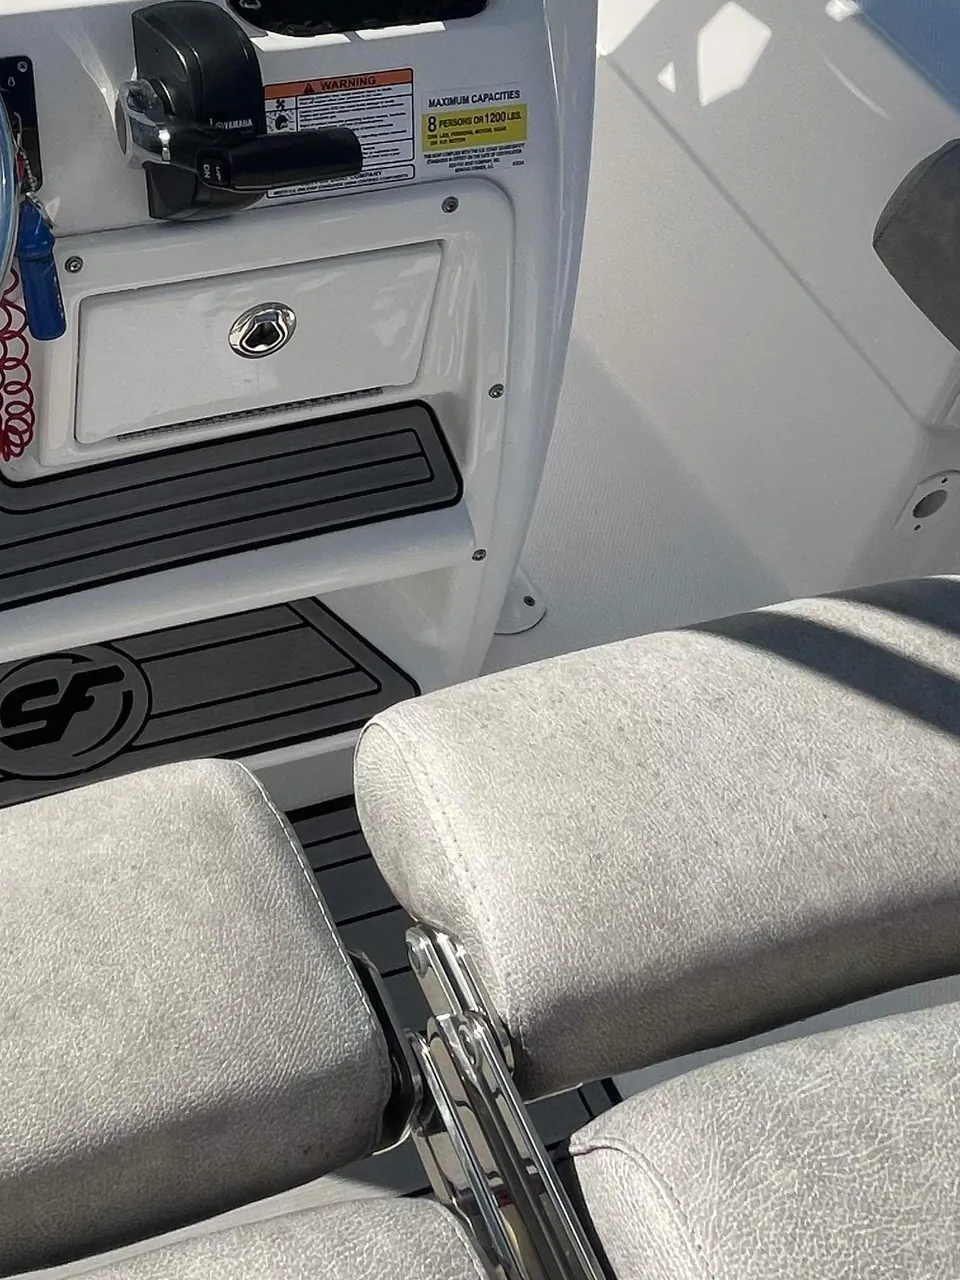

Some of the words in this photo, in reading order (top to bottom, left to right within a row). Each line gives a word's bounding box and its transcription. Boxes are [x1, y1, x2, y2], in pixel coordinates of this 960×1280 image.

[320, 75, 377, 92] WARNING
[428, 95, 470, 108] MAXIMUM
[471, 90, 521, 104] CAPACITIES
[223, 118, 253, 130] YAMAHA
[427, 116, 437, 132] 8
[439, 116, 472, 128] PERSONS
[473, 115, 484, 125] OR
[485, 111, 507, 124] 1200
[507, 111, 522, 121] LBS.
